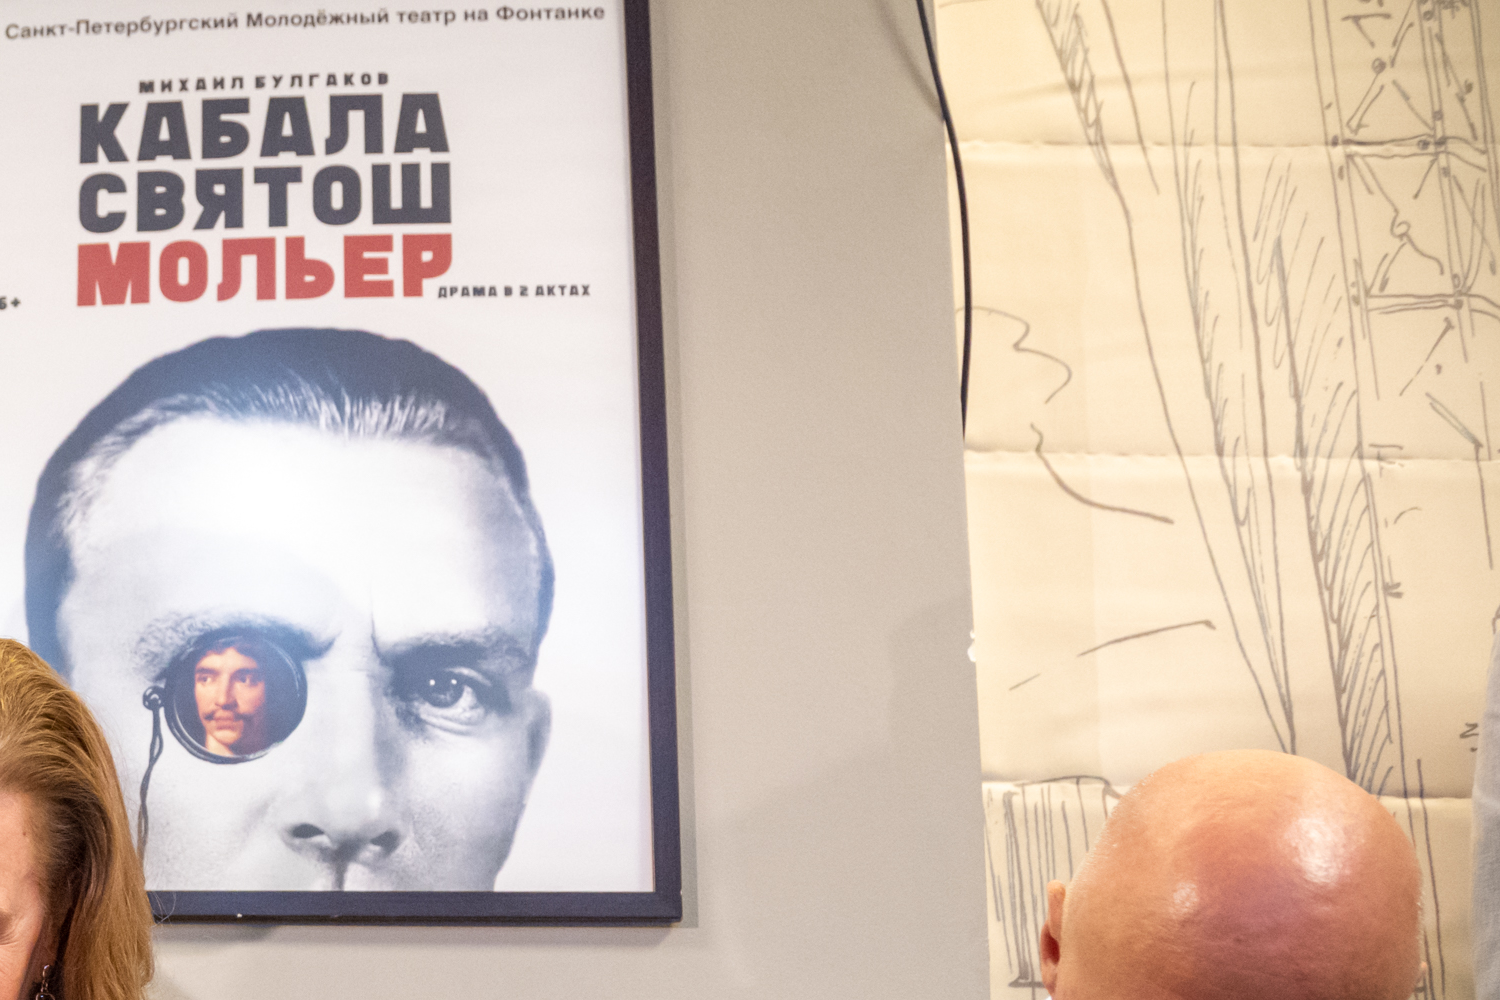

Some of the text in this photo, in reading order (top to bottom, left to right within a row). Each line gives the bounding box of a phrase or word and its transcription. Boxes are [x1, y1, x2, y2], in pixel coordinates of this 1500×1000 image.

[4, 12, 240, 40] Санкт-Петербургский
[245, 7, 390, 29] Молодёжный
[396, 9, 457, 26] театр
[464, 10, 489, 22] на
[496, 5, 606, 21] Фонтанке
[138, 72, 389, 94] МИХАИЛ БУЛГАКОВ
[78, 92, 451, 165] КАБАЛА
[77, 161, 453, 234] СВЯТОШ
[76, 233, 454, 308] МОЛЬЕР
[437, 284, 591, 299] ДРАМА В 2 АКТАХ
